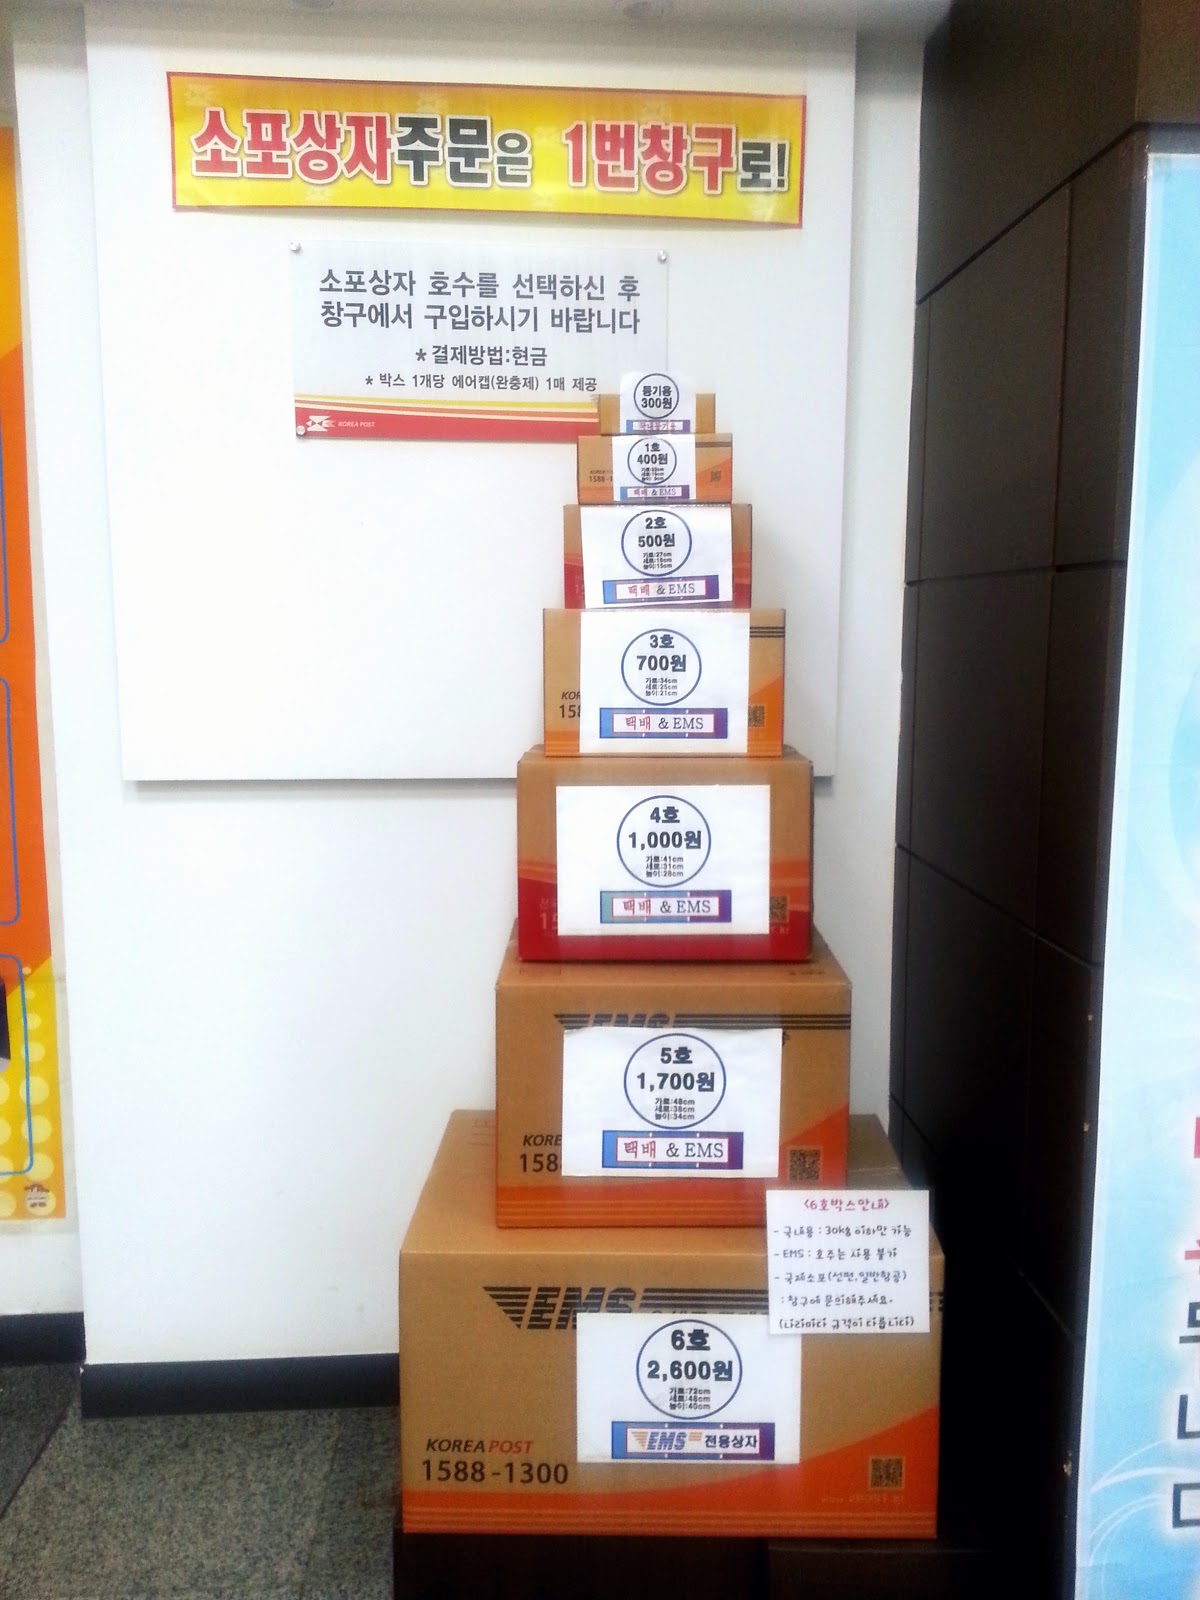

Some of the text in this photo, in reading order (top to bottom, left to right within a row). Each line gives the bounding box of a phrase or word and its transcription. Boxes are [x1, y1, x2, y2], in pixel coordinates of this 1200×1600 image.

[193, 108, 787, 193] 소포상자주문은 1번창구로!
[320, 269, 640, 302] 소포상자 호수를 선택하신 후
[320, 301, 640, 334] 창구에서 구입하시기 바랍니다
[432, 344, 548, 366] 결제방법:현금
[379, 373, 597, 392] 박스 1개당 에어캡(완충제) 1매 제공
[641, 398, 672, 409] 300원
[645, 443, 660, 452] 1호
[637, 454, 668, 465] 400원
[645, 517, 667, 529] 2호
[638, 533, 675, 547] 500원
[628, 583, 695, 597] 택배 & EMS
[649, 634, 674, 648] 3호
[637, 654, 686, 672] 700원
[625, 715, 704, 731] 택배 & EMS
[650, 806, 680, 823] 4호
[629, 830, 701, 850] 1,000원
[622, 899, 711, 914] 택배 & EMS
[660, 1046, 693, 1064] 5호
[637, 1072, 715, 1092] 1,700원
[624, 1141, 724, 1159] 택배 & EMS
[520, 1153, 562, 1173] 158
[784, 1226, 814, 1238] 국내용
[854, 1225, 888, 1236] 이하만
[892, 1225, 912, 1237] 가능
[783, 1249, 804, 1258] EMS
[815, 1248, 846, 1260] 호주는
[850, 1248, 871, 1260] 사용
[876, 1248, 898, 1260] 불가
[788, 1295, 821, 1307] 창구에
[832, 1317, 863, 1329] 규격이
[671, 1329, 711, 1351] 6호
[647, 1360, 733, 1382] 2,600원
[426, 1438, 534, 1454] KOREA POST
[647, 1431, 758, 1450] EMS 전용상자
[422, 1460, 568, 1484] 1588-1300
